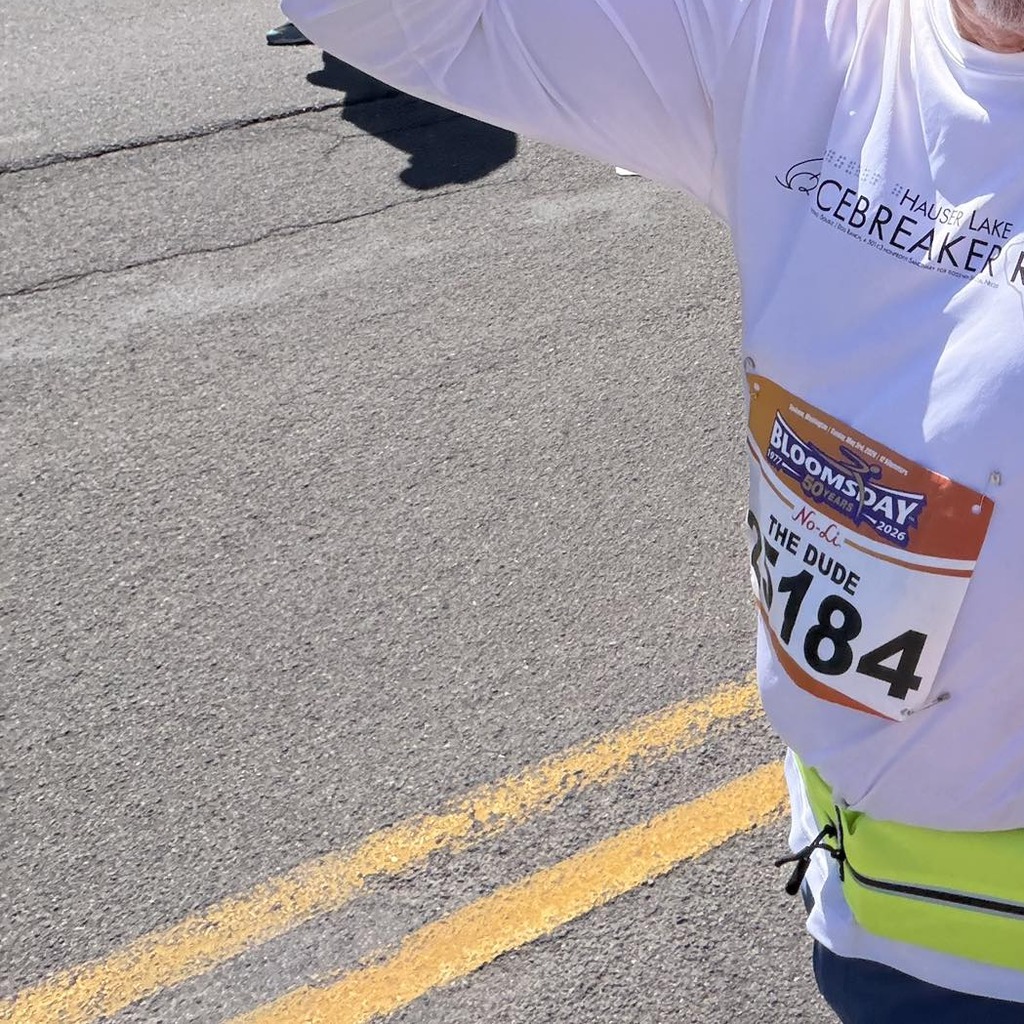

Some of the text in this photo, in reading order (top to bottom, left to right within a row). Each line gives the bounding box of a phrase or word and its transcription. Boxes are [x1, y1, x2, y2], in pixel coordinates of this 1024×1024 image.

[900, 189, 964, 226] HAUSER
[969, 210, 1013, 239] LAKE
[767, 449, 783, 465] 1977
[770, 418, 919, 525] BLOOMSDAY
[802, 475, 854, 512] 50 YEARS
[792, 506, 842, 548] No-Li
[876, 521, 907, 541] 2026
[768, 514, 861, 596] THE DUDE
